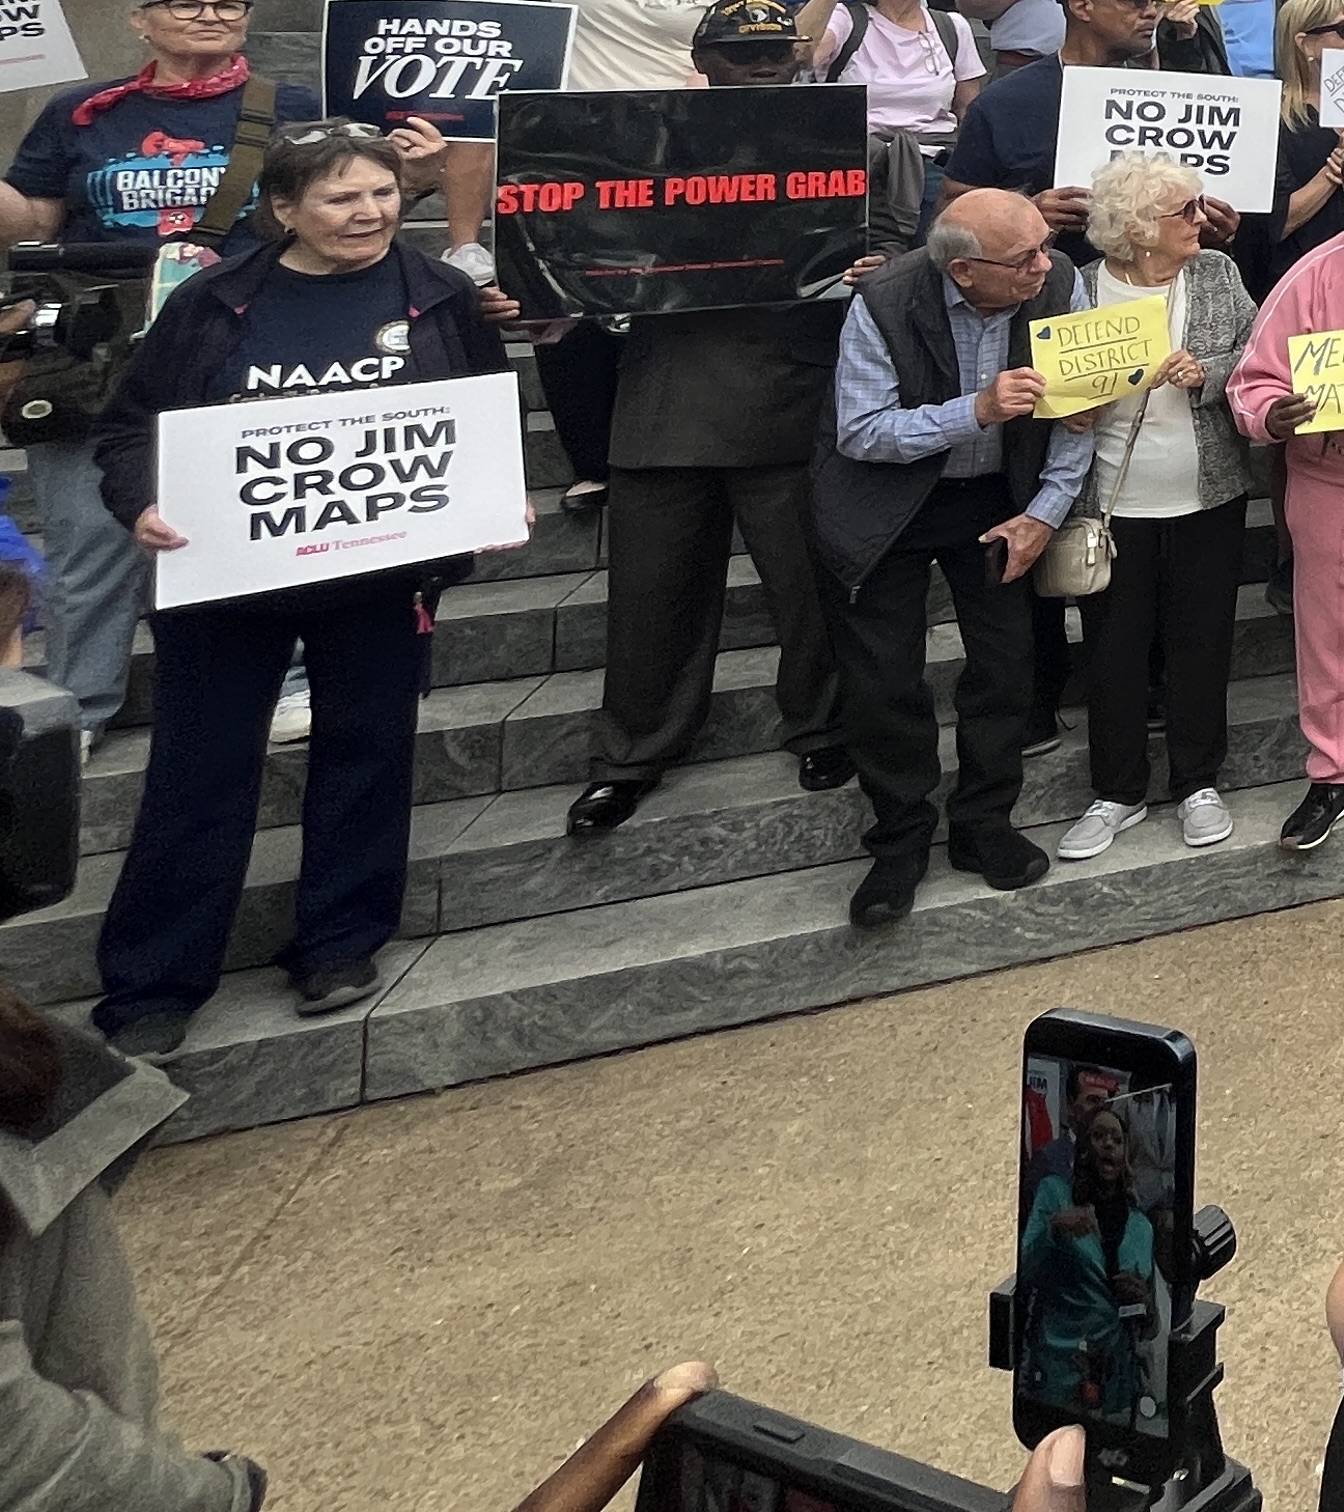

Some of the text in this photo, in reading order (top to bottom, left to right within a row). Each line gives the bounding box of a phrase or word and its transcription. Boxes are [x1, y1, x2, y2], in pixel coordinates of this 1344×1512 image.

[377, 18, 503, 38] HANDS
[363, 38, 513, 58] OFF OUR
[352, 55, 525, 101] VOTE
[1105, 99, 1240, 128] NO JIM
[1104, 125, 1238, 152] CROW
[498, 169, 867, 215] STOP THE POWER GRAB
[1056, 315, 1143, 351] DEFEND
[246, 355, 405, 391] NAACP
[1057, 337, 1151, 378] DISTRICT
[241, 405, 450, 439] PROTECT THE SOUTH:
[235, 419, 456, 475] NO JIM
[238, 450, 455, 506] CROW
[249, 483, 450, 542] MAPS
[295, 531, 408, 557] ACLU Tennessee
